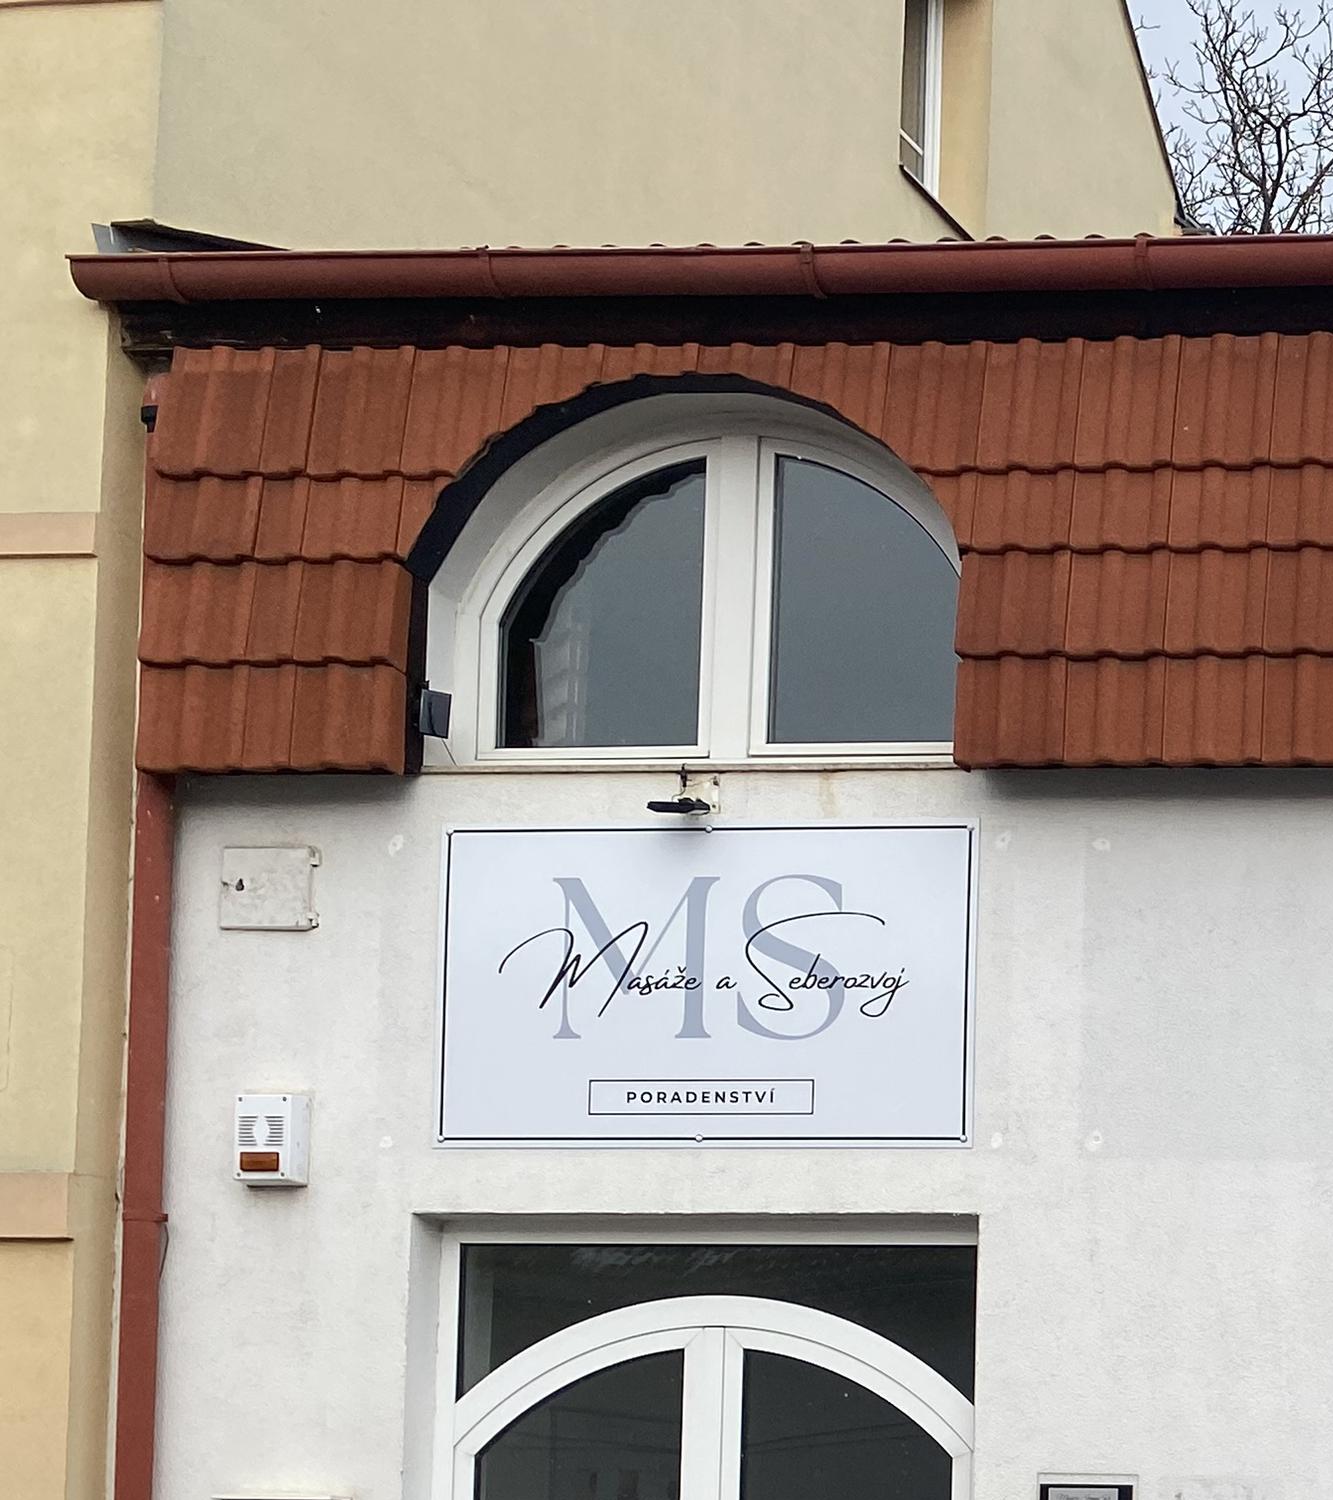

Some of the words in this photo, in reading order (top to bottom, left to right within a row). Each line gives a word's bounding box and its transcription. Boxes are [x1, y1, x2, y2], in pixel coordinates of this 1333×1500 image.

[499, 921, 702, 1018] Masáže
[715, 974, 737, 992] a
[744, 911, 909, 1018] Seberozvoj
[552, 873, 845, 1041] MS
[626, 1087, 777, 1104] PORADENSTVÍ
